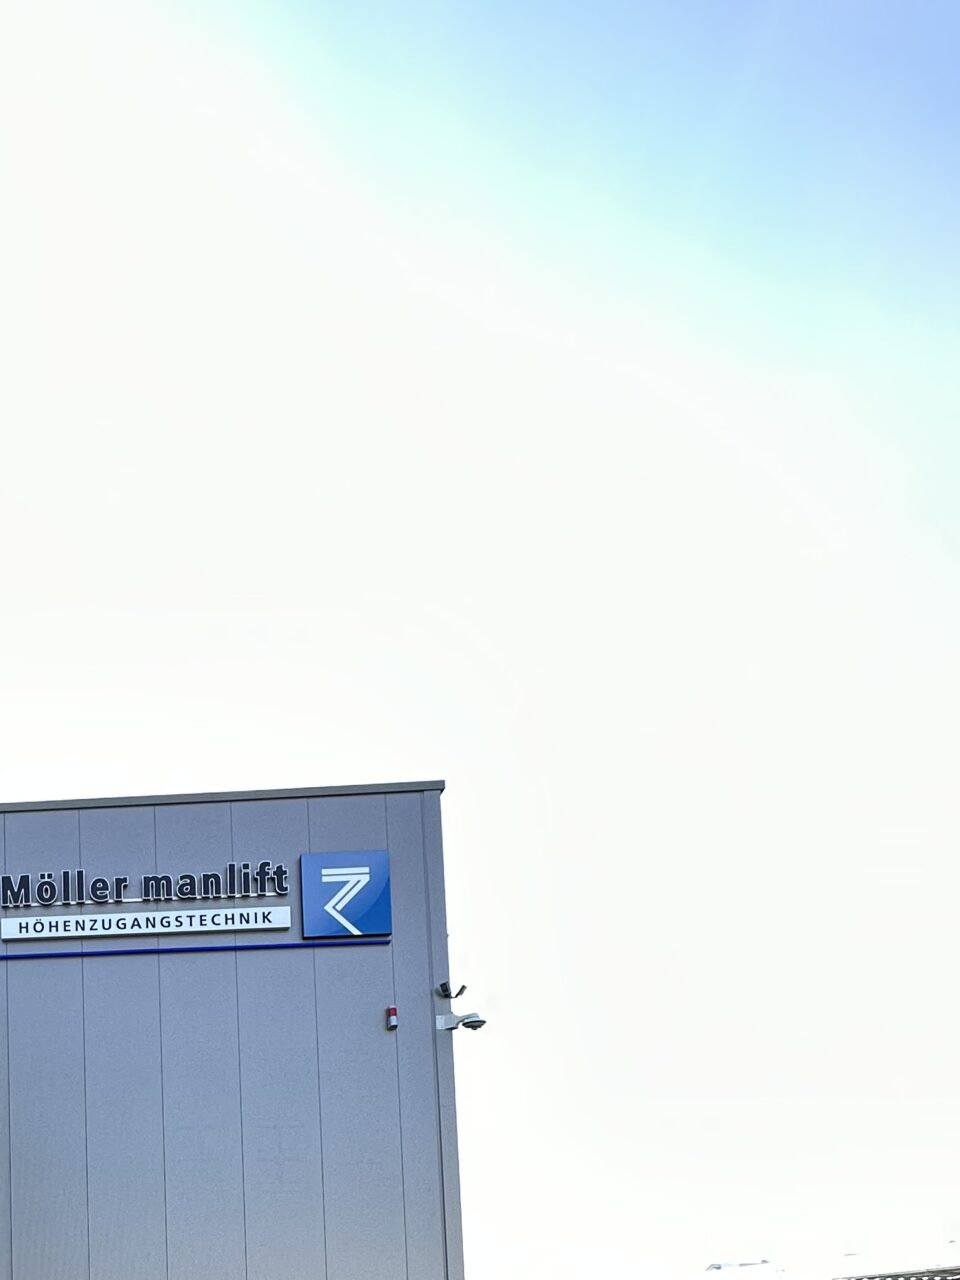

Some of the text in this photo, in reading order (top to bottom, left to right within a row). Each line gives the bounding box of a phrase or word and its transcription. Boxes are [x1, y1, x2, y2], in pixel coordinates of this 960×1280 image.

[0, 861, 289, 907] Möller manlift
[19, 911, 273, 934] HÖHENZUGANGSTECHNIK
